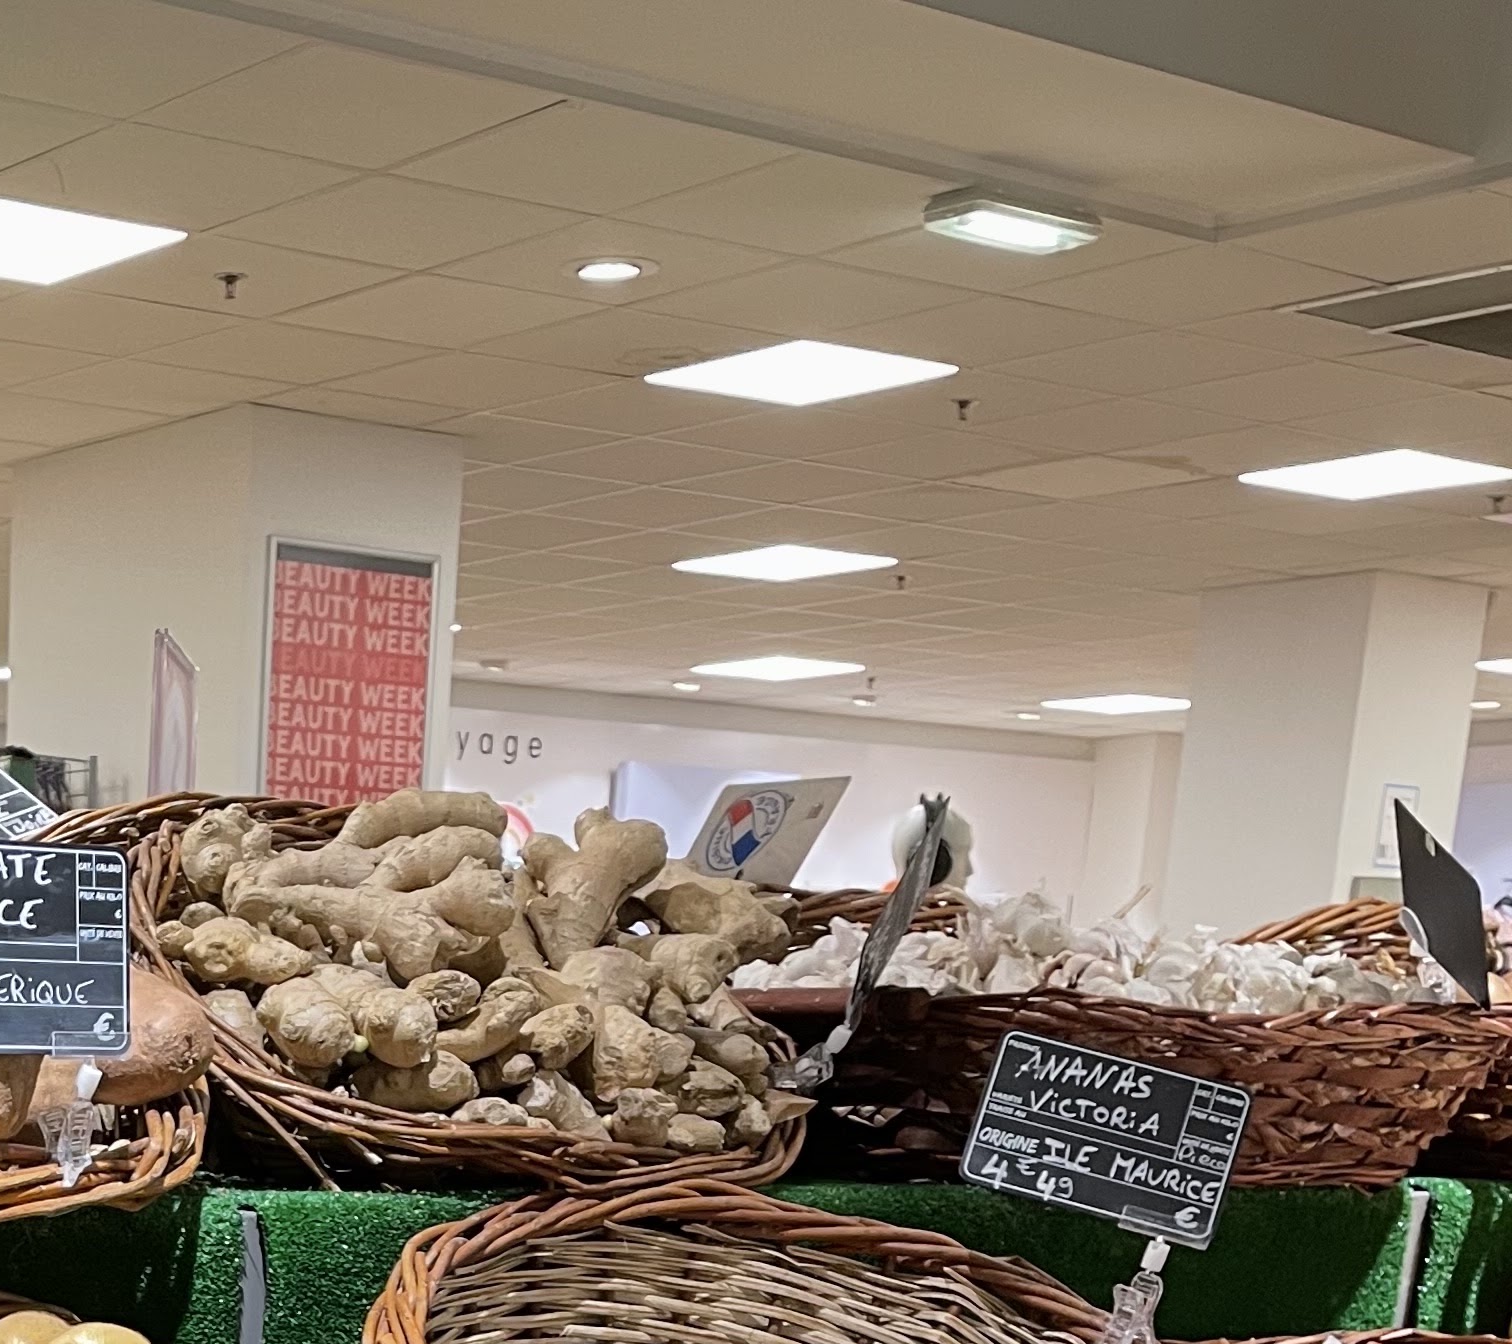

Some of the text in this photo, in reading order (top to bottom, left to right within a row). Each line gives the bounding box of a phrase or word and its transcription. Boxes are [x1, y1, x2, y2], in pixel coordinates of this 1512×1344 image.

[366, 570, 432, 602] WEEK
[365, 598, 431, 629] WEEK
[363, 625, 429, 657] WEEK
[274, 645, 356, 677] EAUTY
[360, 681, 425, 711] WEEK
[359, 709, 424, 738] WEEK
[357, 735, 422, 765] WEEK
[355, 763, 421, 790] WEEK
[1015, 1050, 1154, 1098] ANANAS
[978, 1126, 1040, 1153] ORIGINE
